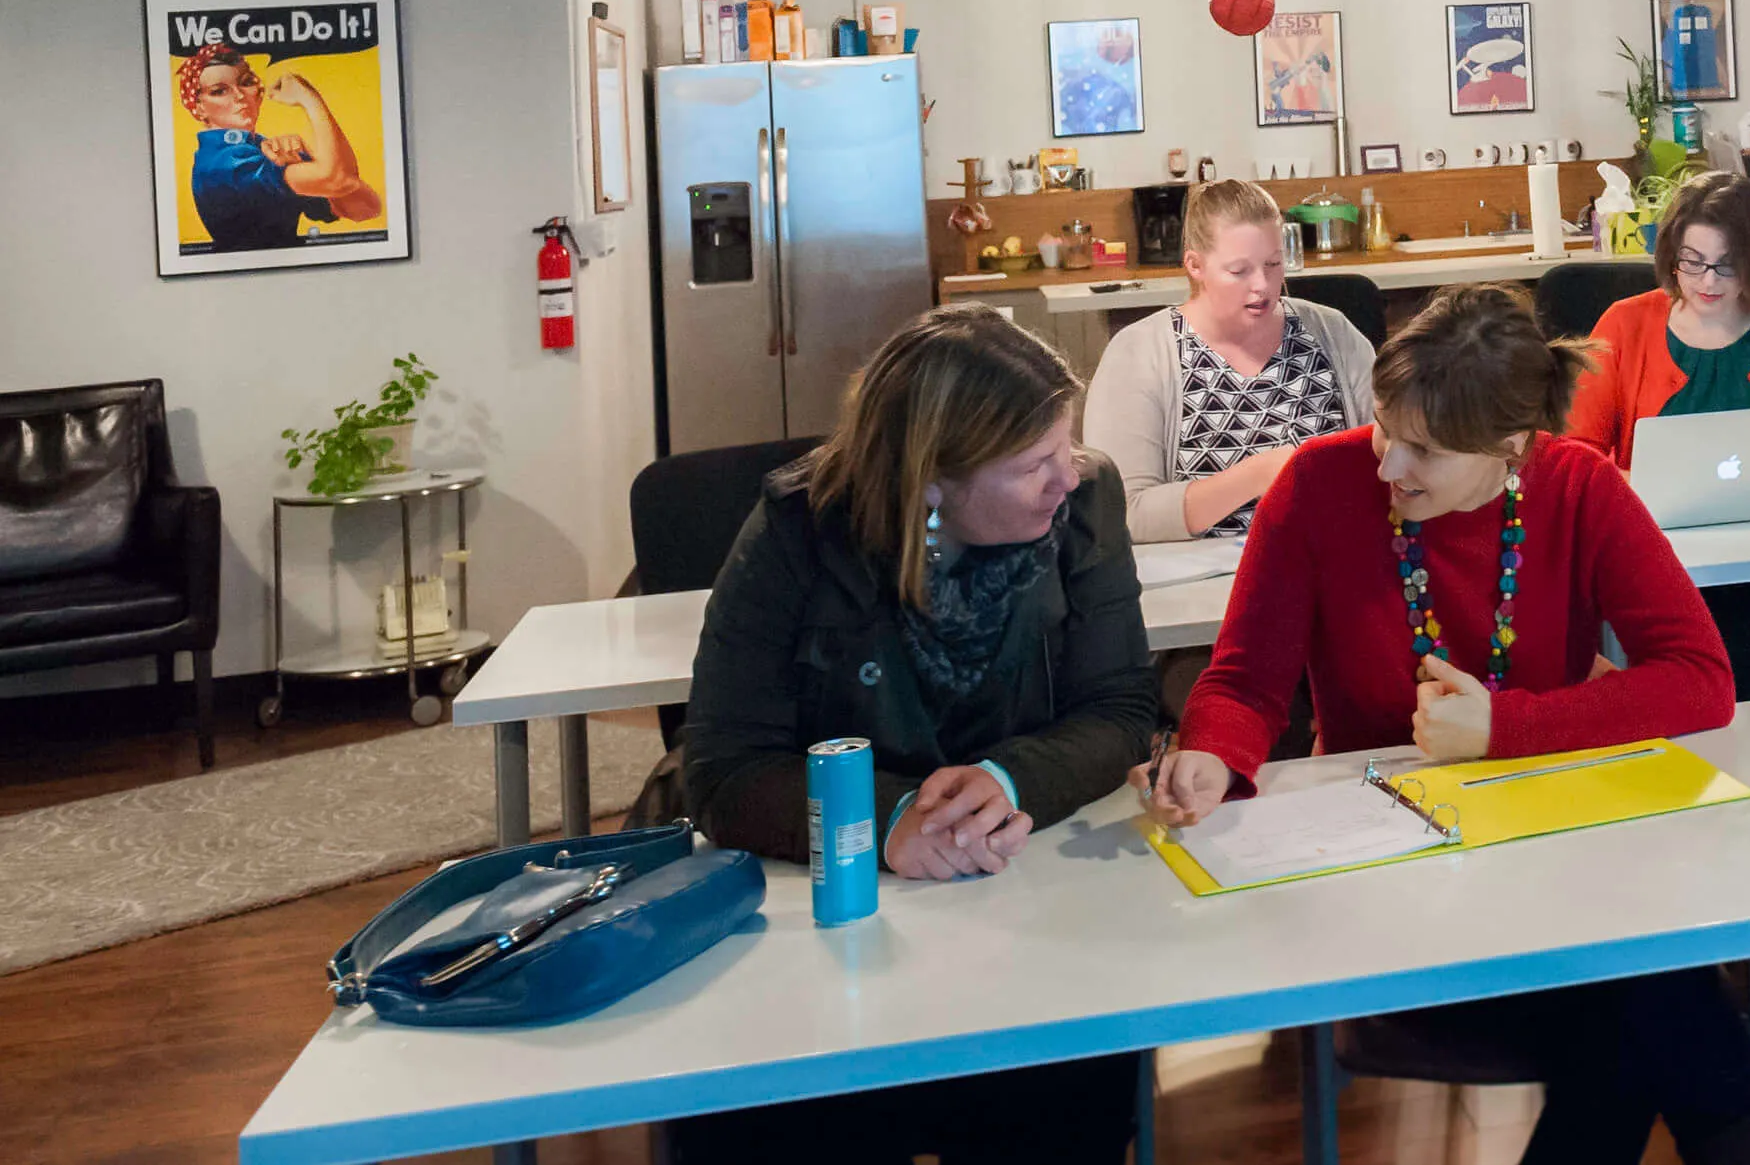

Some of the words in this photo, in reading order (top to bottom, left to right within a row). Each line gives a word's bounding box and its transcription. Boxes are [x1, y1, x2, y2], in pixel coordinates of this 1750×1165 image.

[175, 16, 223, 47] We
[228, 13, 285, 45] Can
[291, 11, 333, 41] Do
[339, 8, 372, 39] It!
[1285, 28, 1322, 37] EMPIRE
